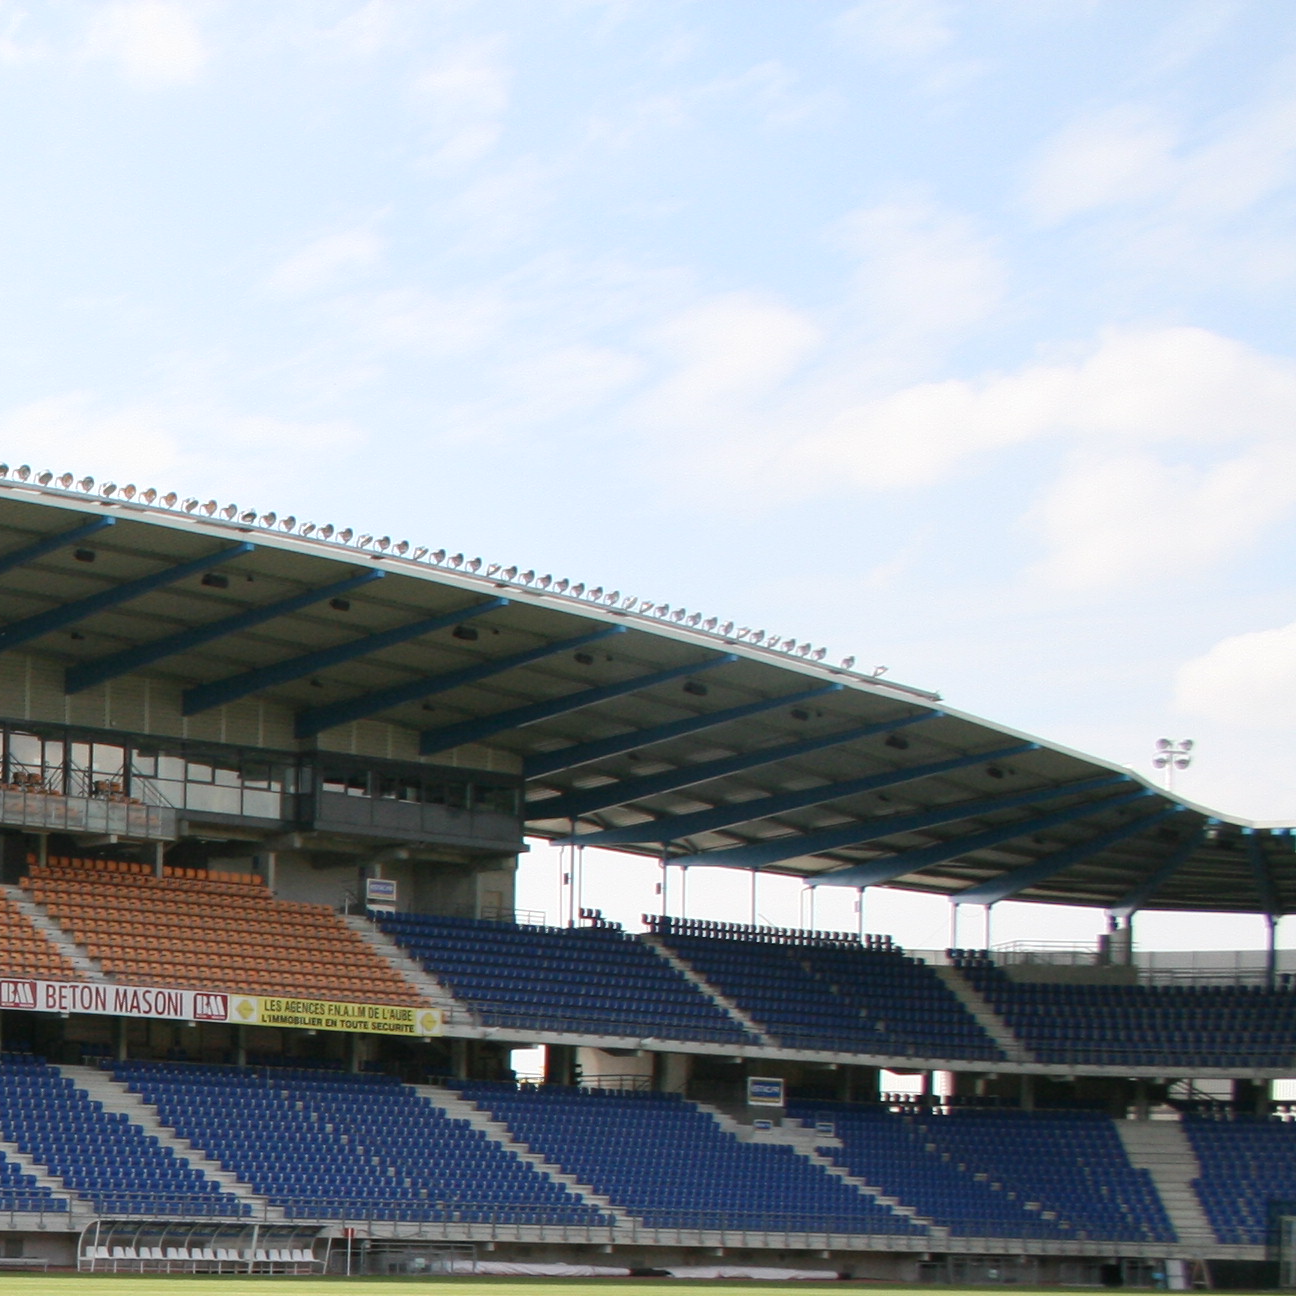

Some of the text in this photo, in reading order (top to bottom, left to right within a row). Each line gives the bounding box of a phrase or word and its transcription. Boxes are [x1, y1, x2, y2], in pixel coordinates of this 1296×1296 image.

[46, 984, 183, 1016] BETON MASONI
[264, 1000, 282, 1012] LES
[284, 1001, 325, 1015] AGENCES
[368, 1007, 379, 1018] DE
[382, 1008, 412, 1021] L'AUBE
[262, 1014, 414, 1033] L'IMMOBILIER EN TOUTE SECURITE
